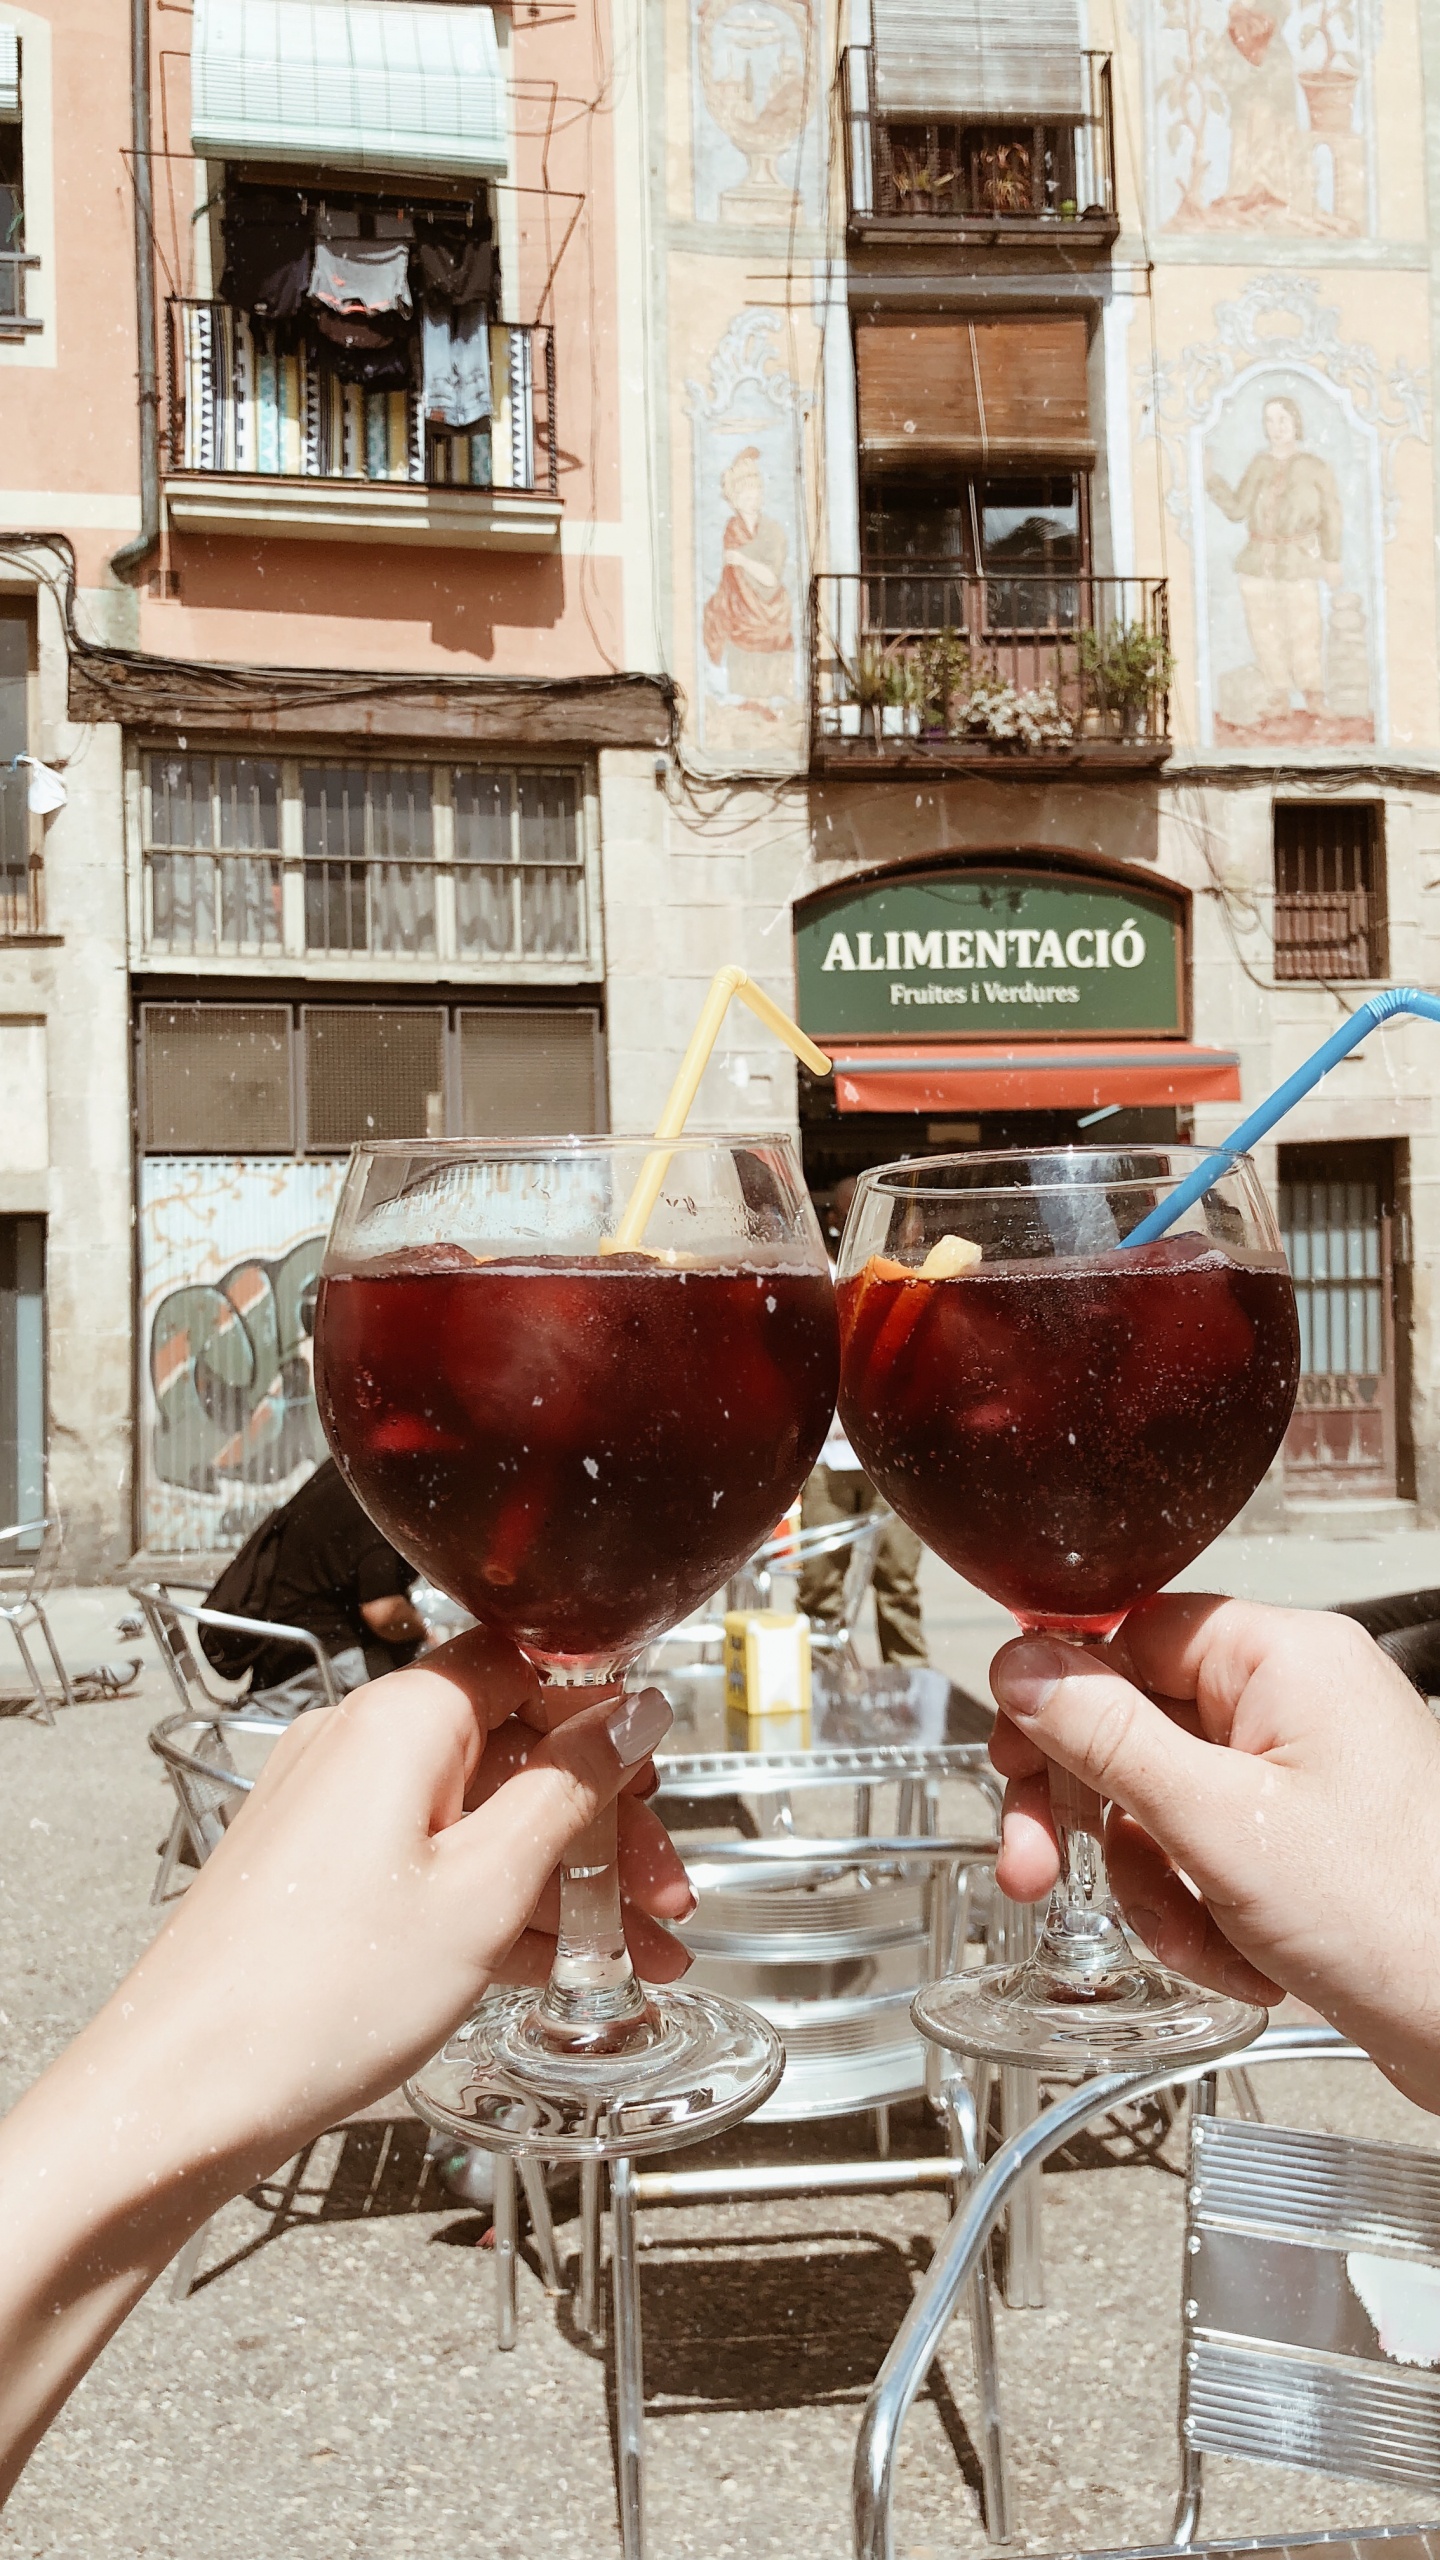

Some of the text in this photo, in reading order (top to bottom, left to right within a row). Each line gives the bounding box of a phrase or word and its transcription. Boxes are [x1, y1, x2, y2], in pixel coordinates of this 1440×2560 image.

[821, 918, 1146, 971] ALIMENTACIÓ
[890, 980, 1080, 1005] Fruites i Verdures
